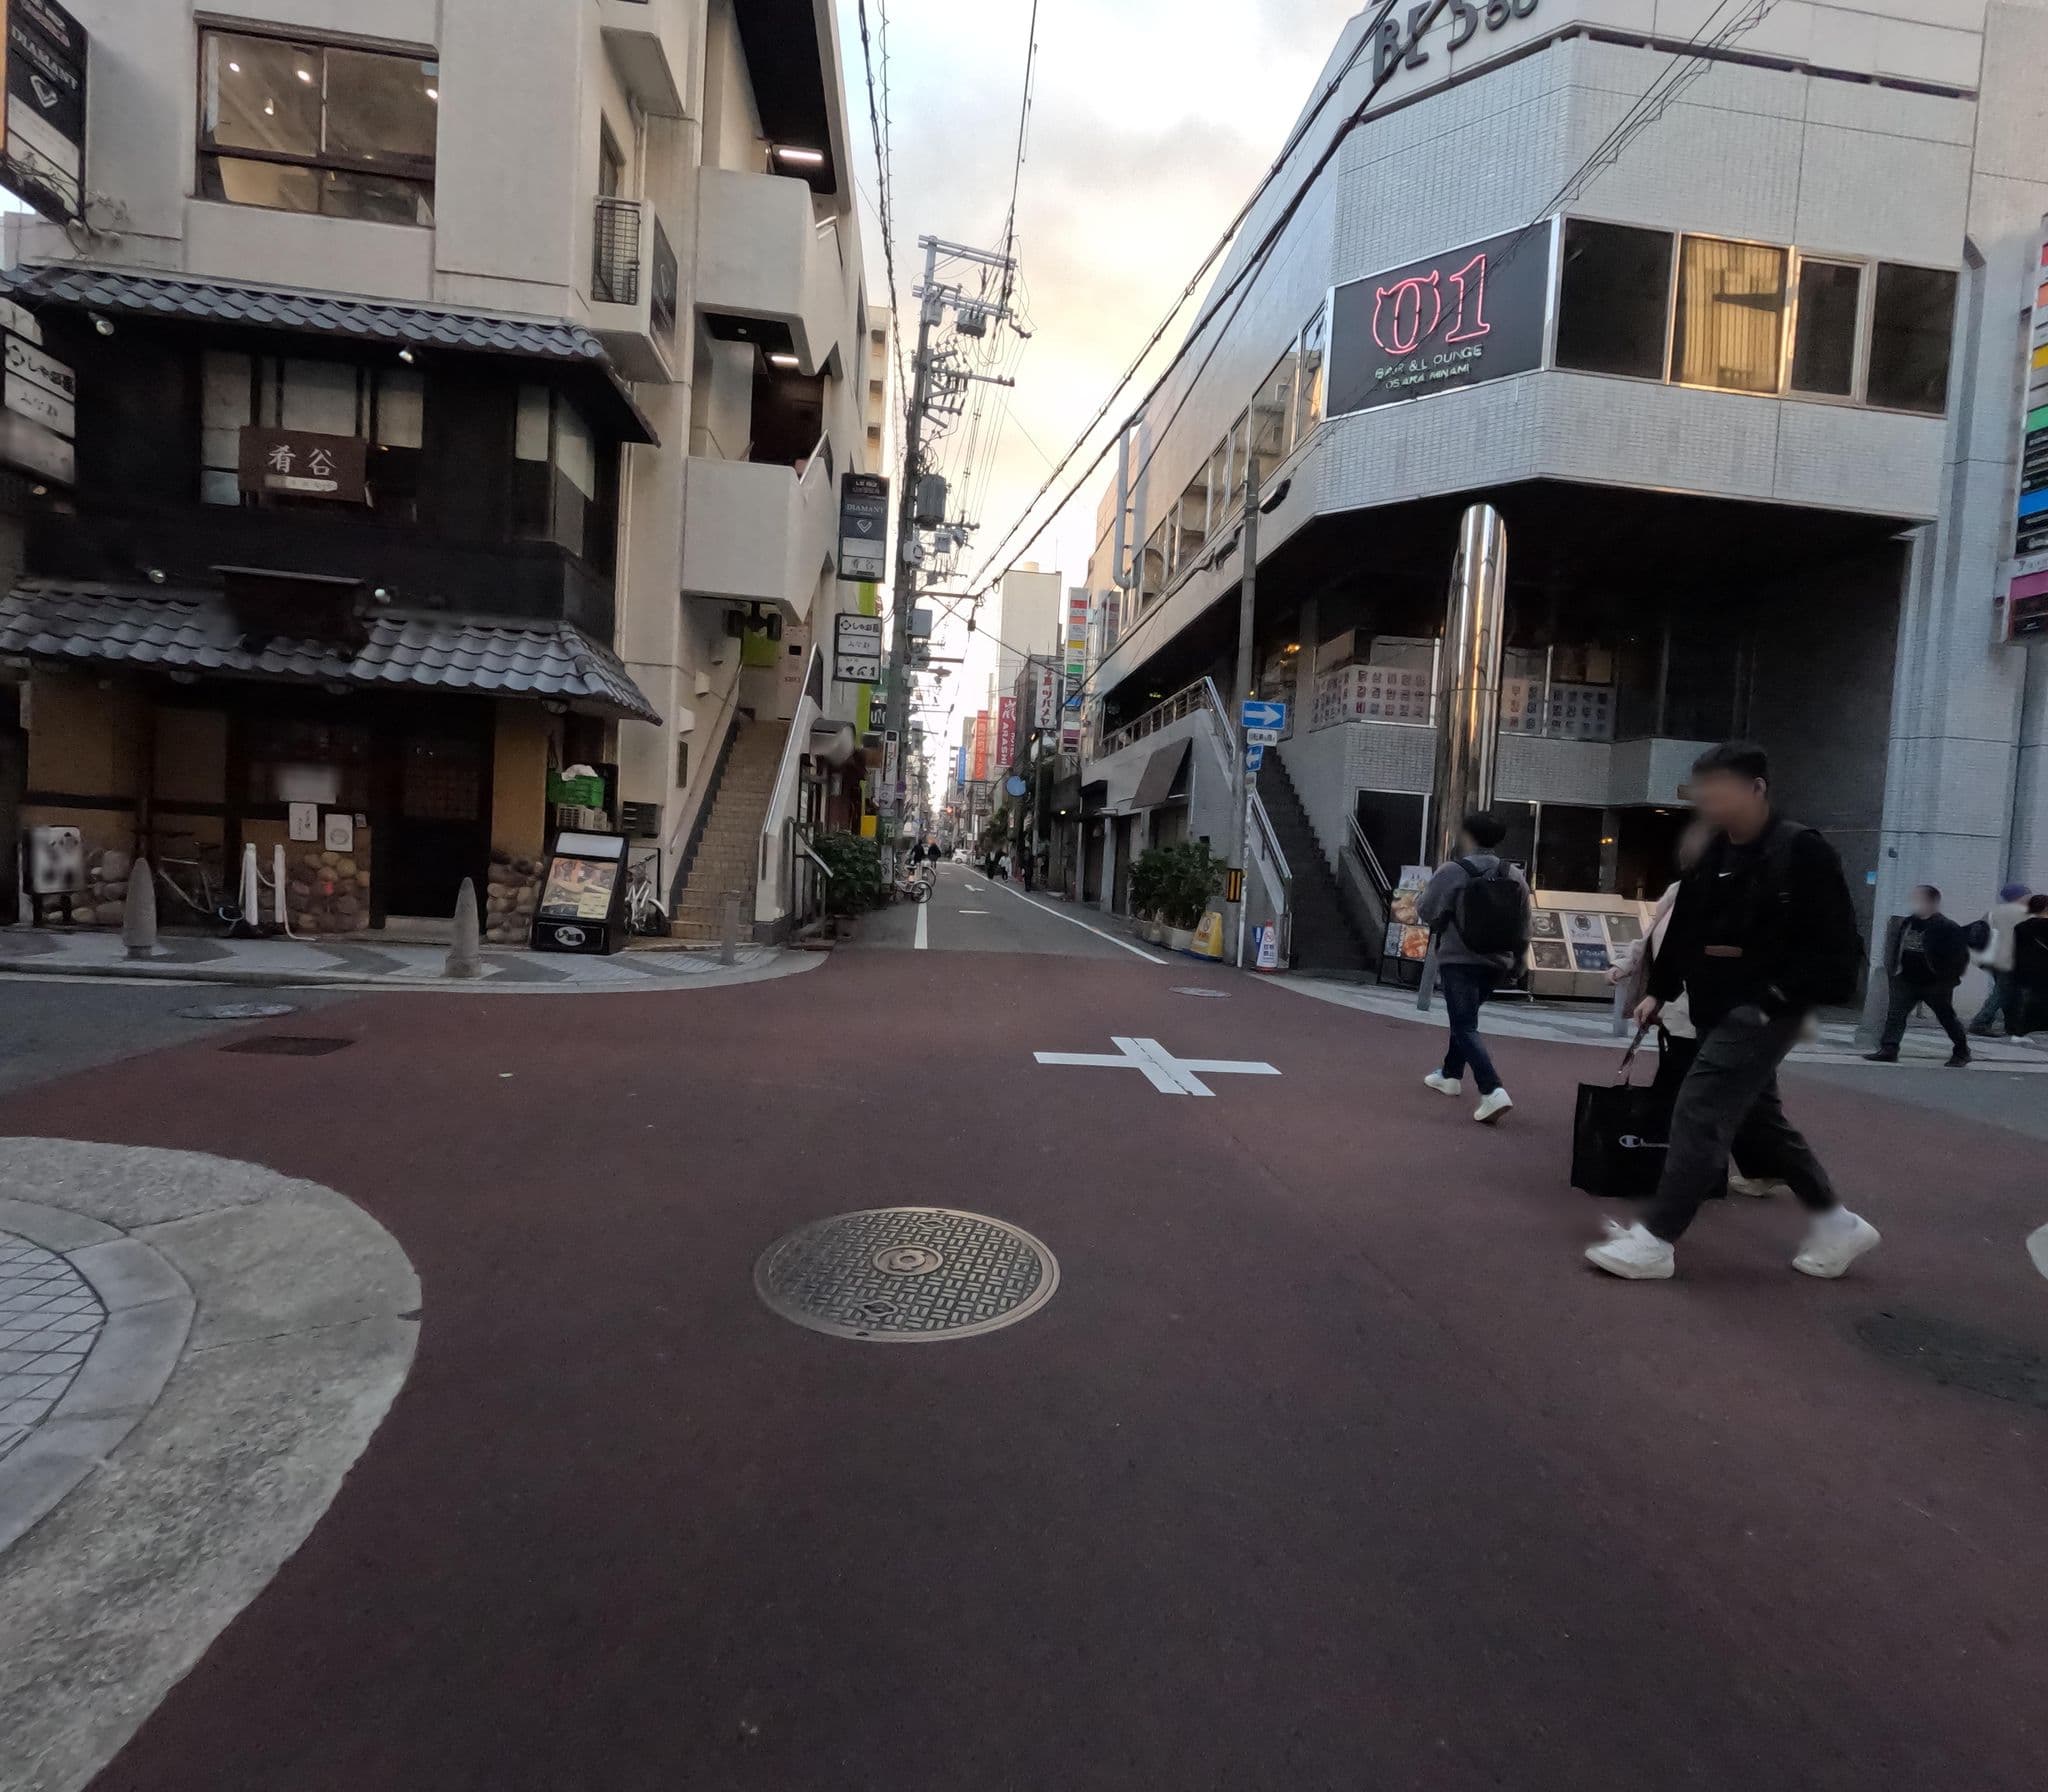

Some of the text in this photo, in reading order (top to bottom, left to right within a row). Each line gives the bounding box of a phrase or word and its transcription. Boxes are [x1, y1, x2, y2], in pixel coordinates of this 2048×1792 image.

[1375, 363, 1405, 380] BAR
[1385, 363, 1471, 389] OSAKA MINAMI
[1000, 721, 1010, 765] ARASHI
